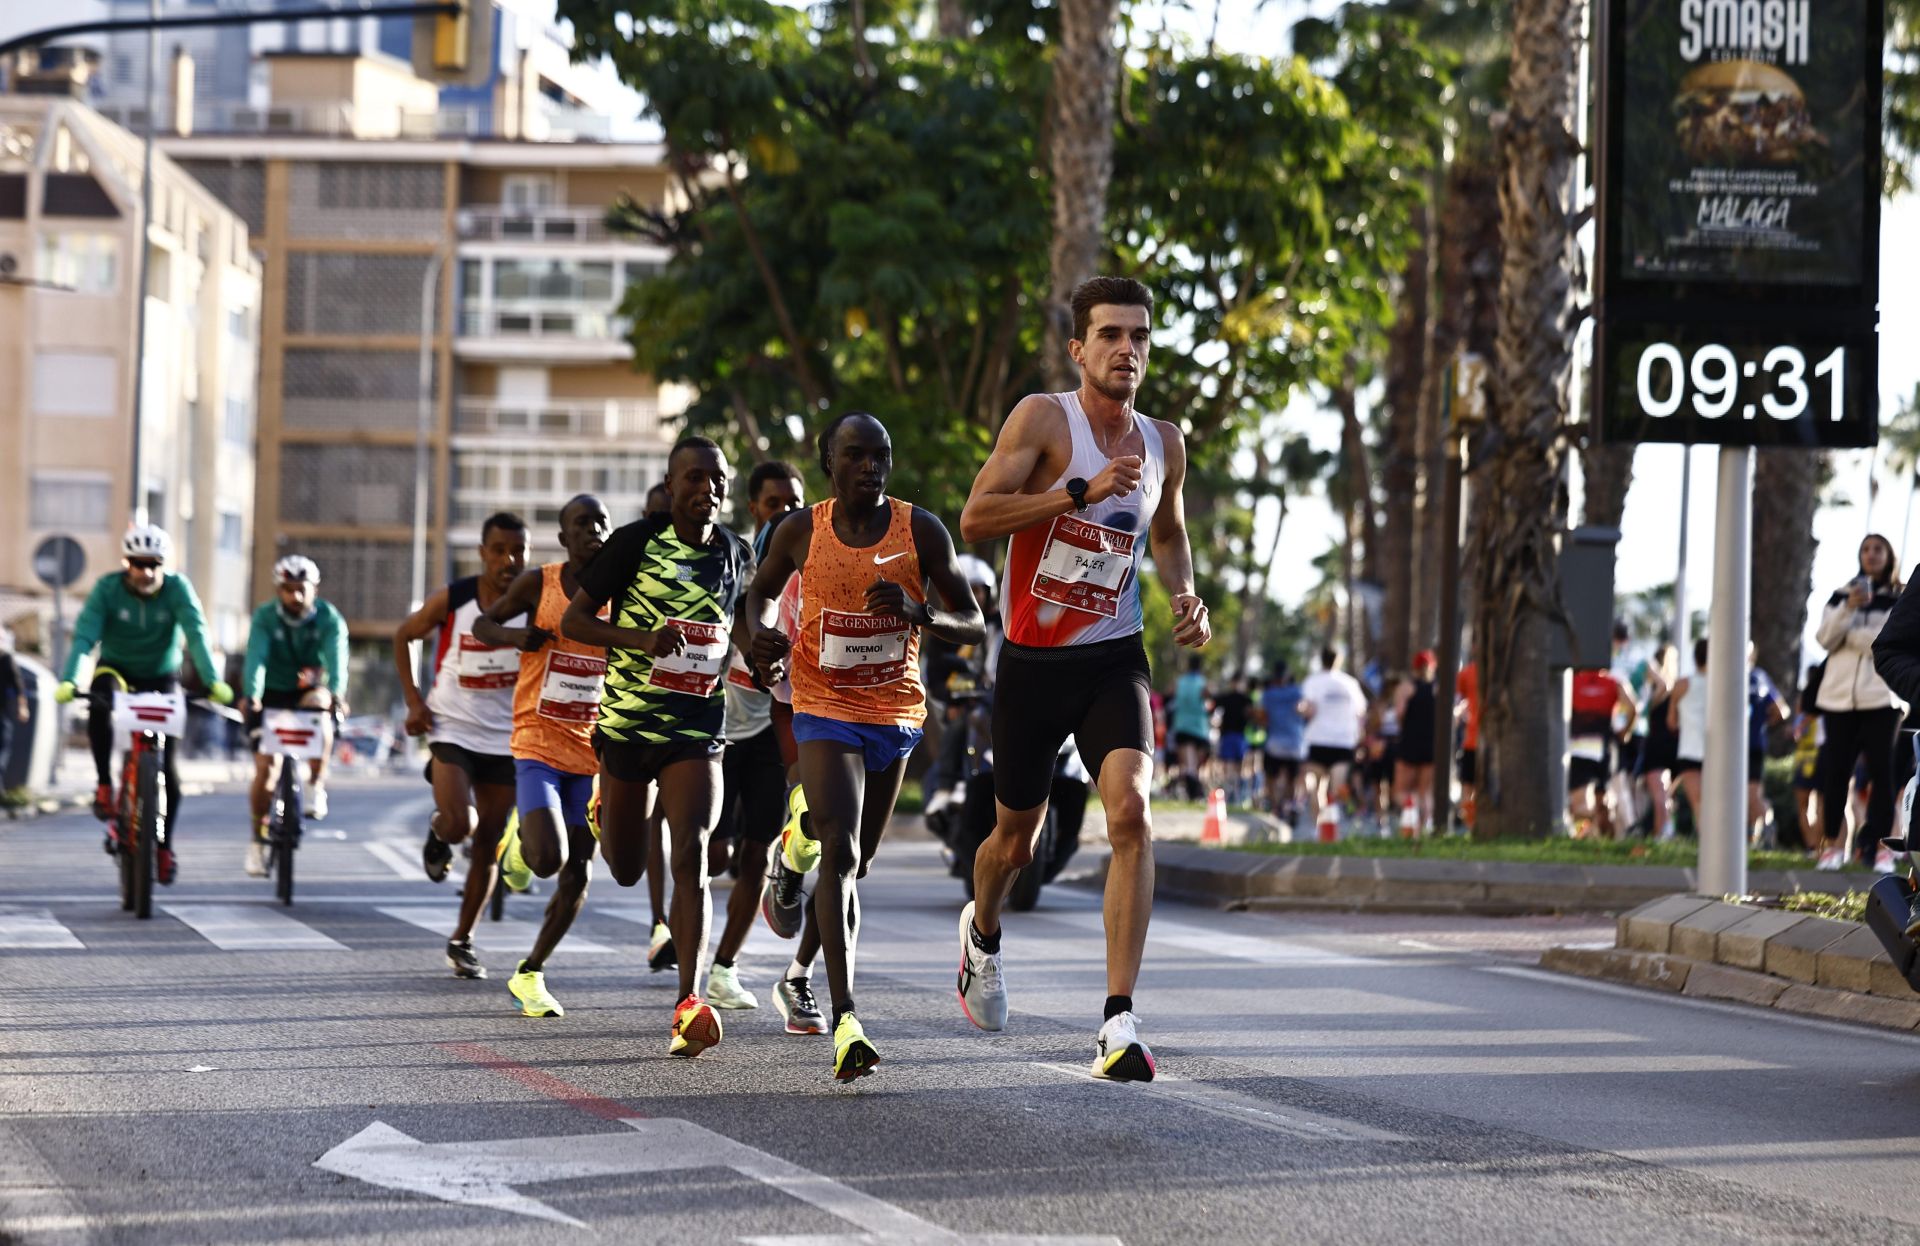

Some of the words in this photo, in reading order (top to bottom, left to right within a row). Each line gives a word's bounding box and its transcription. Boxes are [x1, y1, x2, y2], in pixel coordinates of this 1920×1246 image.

[1679, 0, 1809, 65] SMASH
[1637, 342, 1845, 421] 09:31
[1079, 526, 1129, 550] GENERALI
[686, 652, 708, 662] KIGEN
[845, 644, 883, 653] KWEMOI
